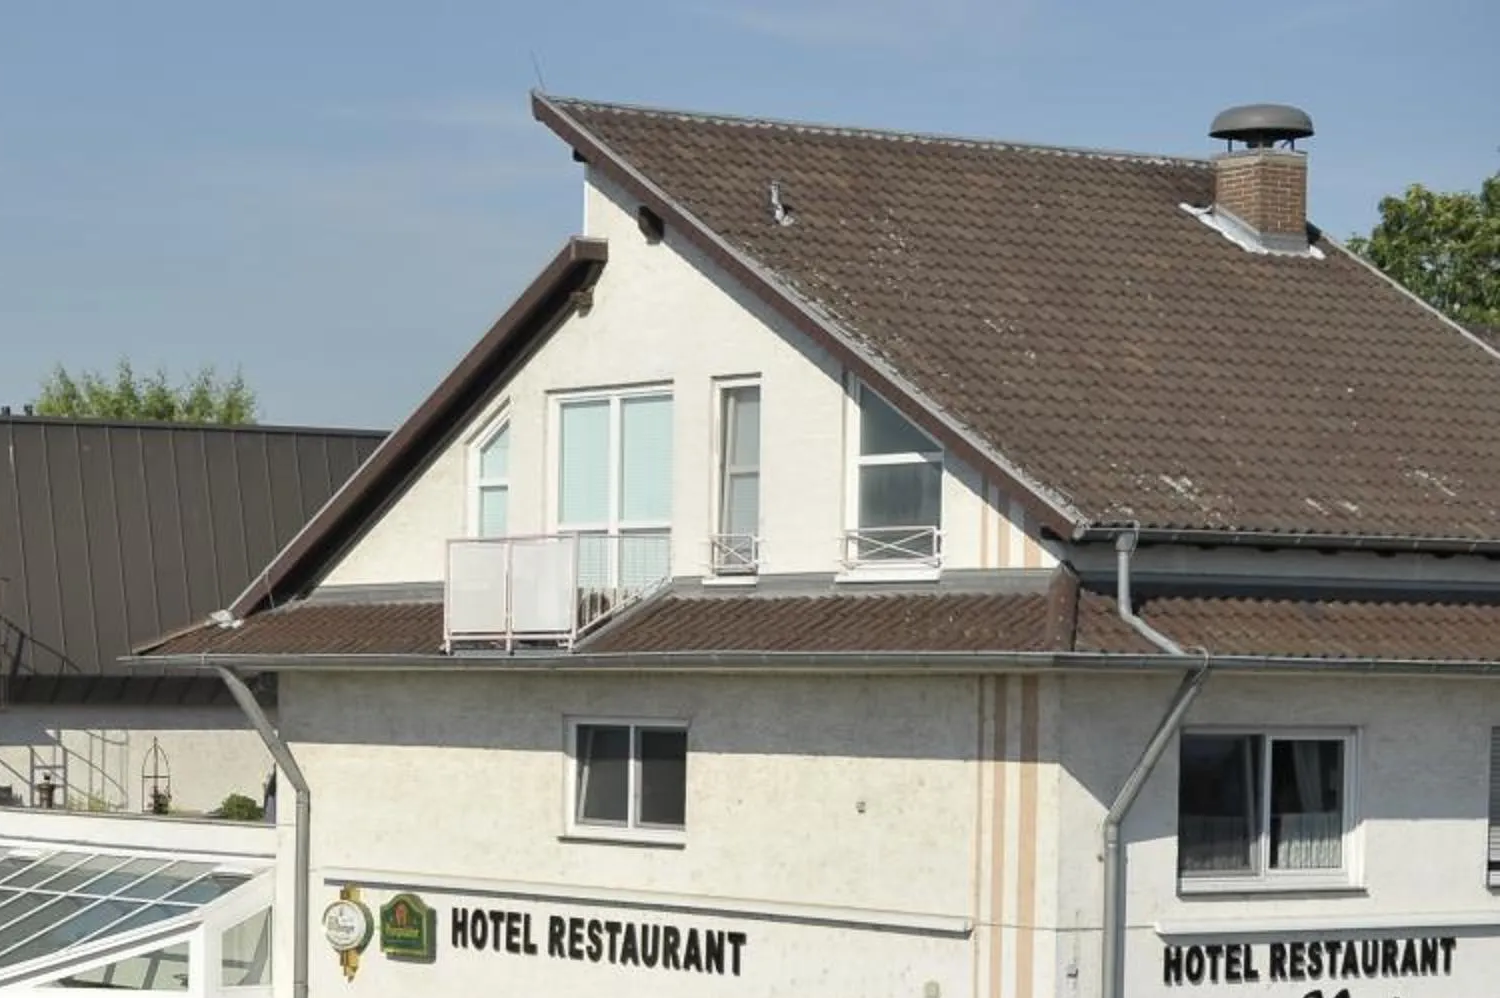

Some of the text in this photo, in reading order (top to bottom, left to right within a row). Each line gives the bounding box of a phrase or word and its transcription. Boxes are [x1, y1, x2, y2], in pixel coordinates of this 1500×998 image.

[451, 906, 747, 977] HOTEL RESTAURANT
[1163, 936, 1457, 985] HOTEL RESTAURANT
